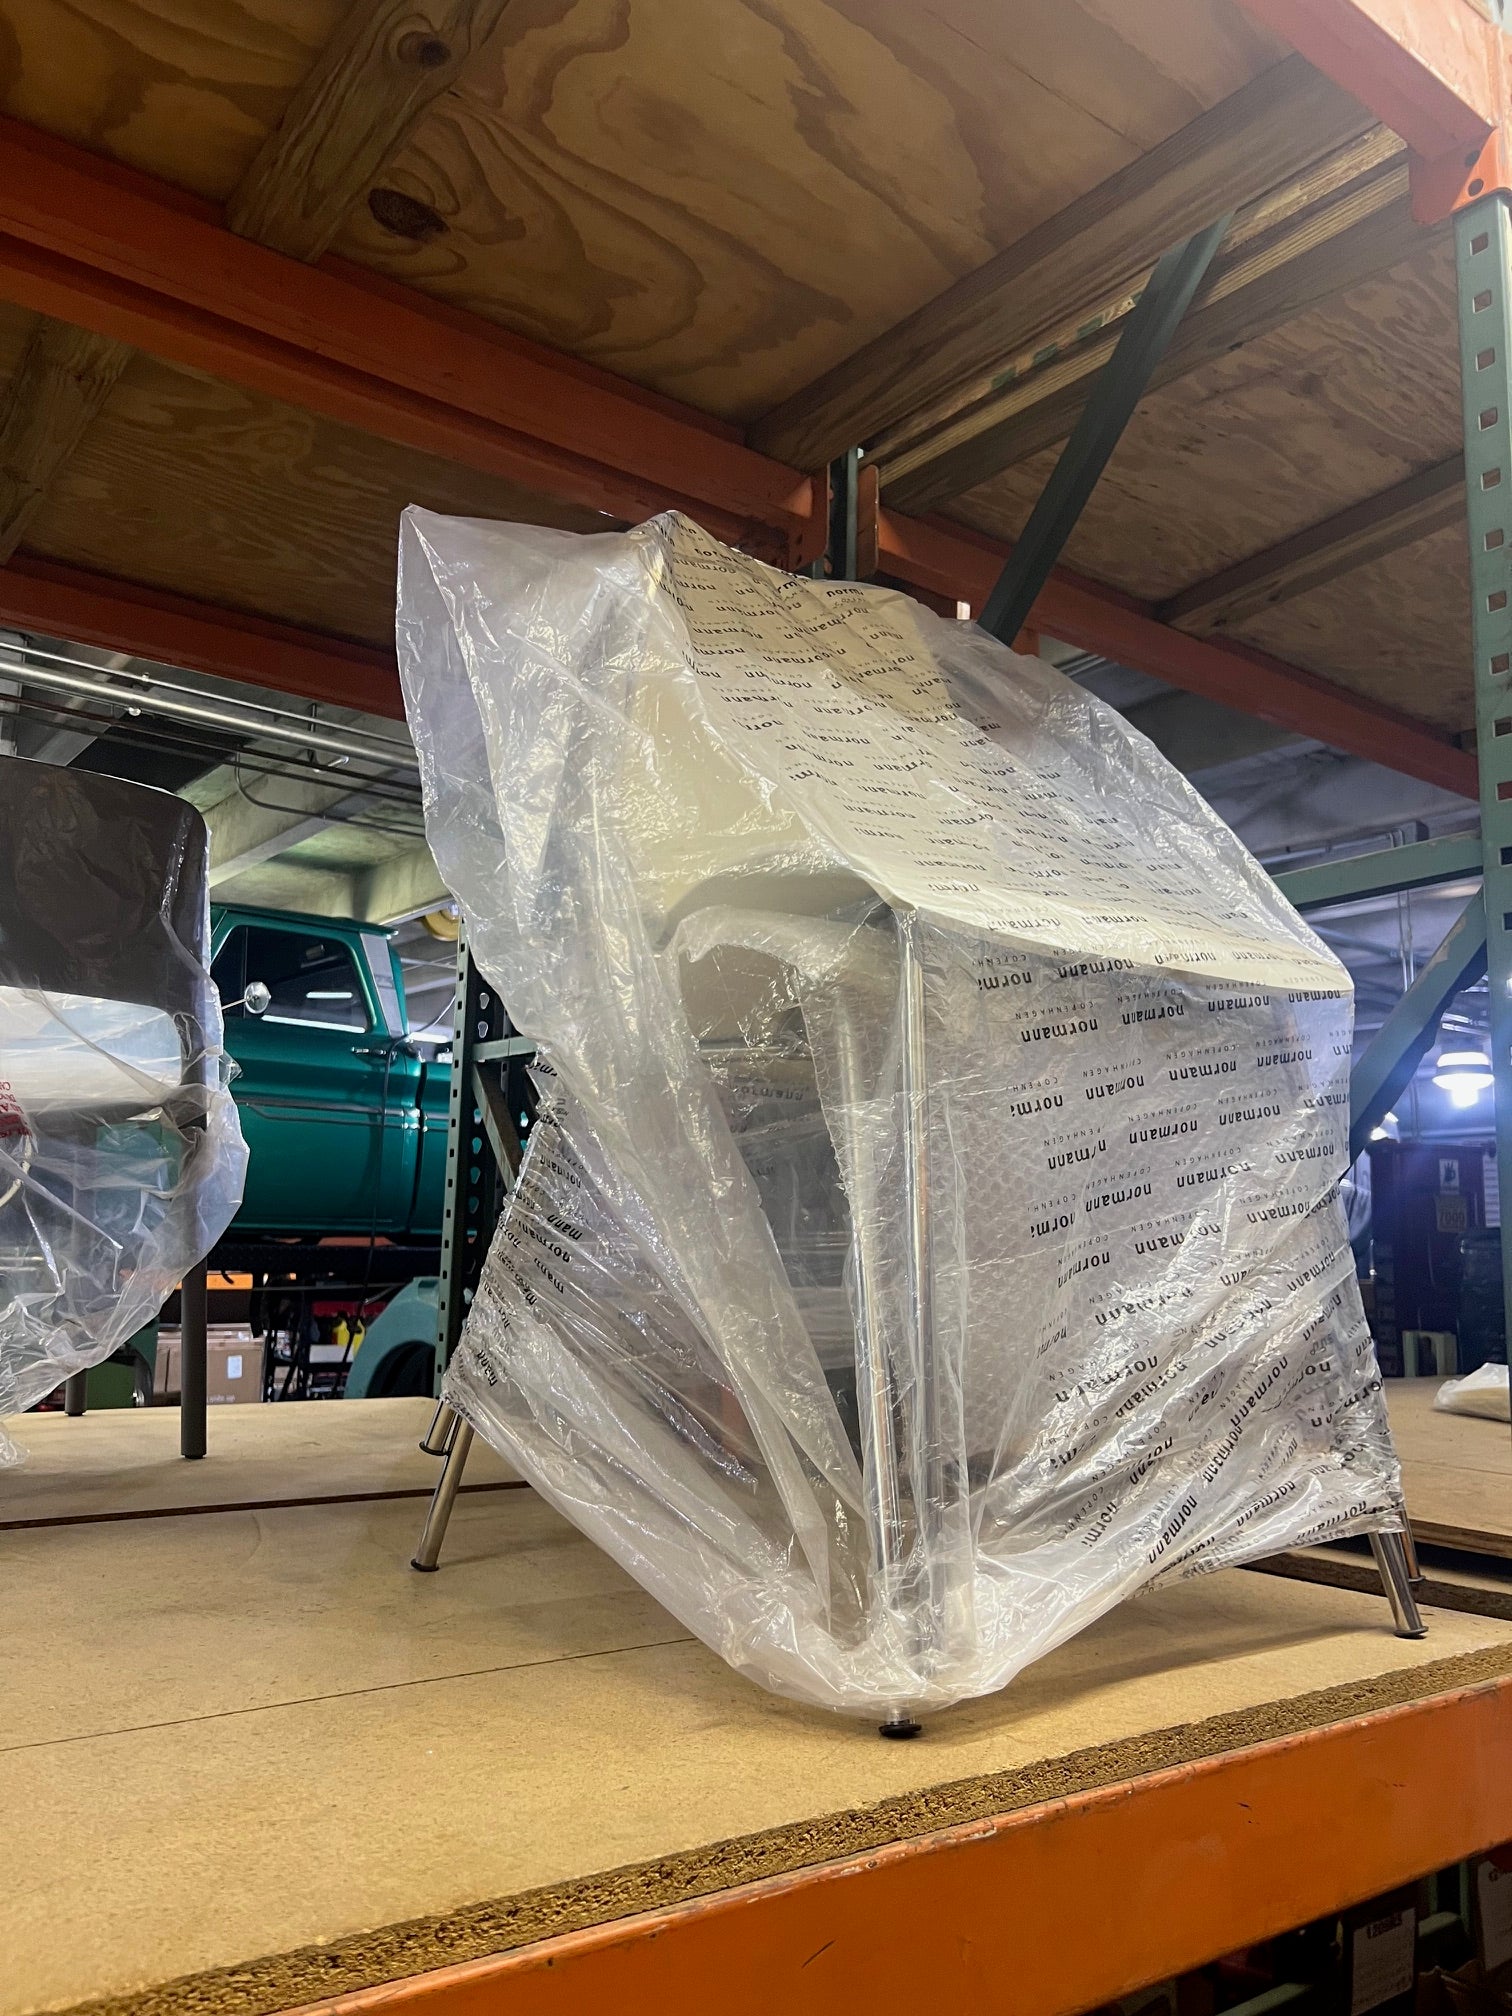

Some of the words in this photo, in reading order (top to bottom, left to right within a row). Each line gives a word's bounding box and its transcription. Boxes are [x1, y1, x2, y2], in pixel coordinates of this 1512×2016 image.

[1057, 958, 1134, 978] normann
[1208, 996, 1269, 1012] normann
[1288, 990, 1340, 1004] normann
[1015, 1002, 1093, 1020] COPENHAGEN
[1122, 1004, 1184, 1026] normann
[1021, 1019, 1098, 1043] normann
[1257, 1050, 1312, 1068] normann
[1168, 1060, 1236, 1081] normann
[1219, 1105, 1281, 1127] normann
[1129, 1120, 1198, 1144] normann
[1275, 1144, 1334, 1164] normann
[1086, 1184, 1151, 1213] normann
[1246, 1202, 1310, 1224] normann
[1287, 1252, 1335, 1292] normann
[1230, 1356, 1288, 1427] normann
[1148, 1495, 1197, 1564] normann
